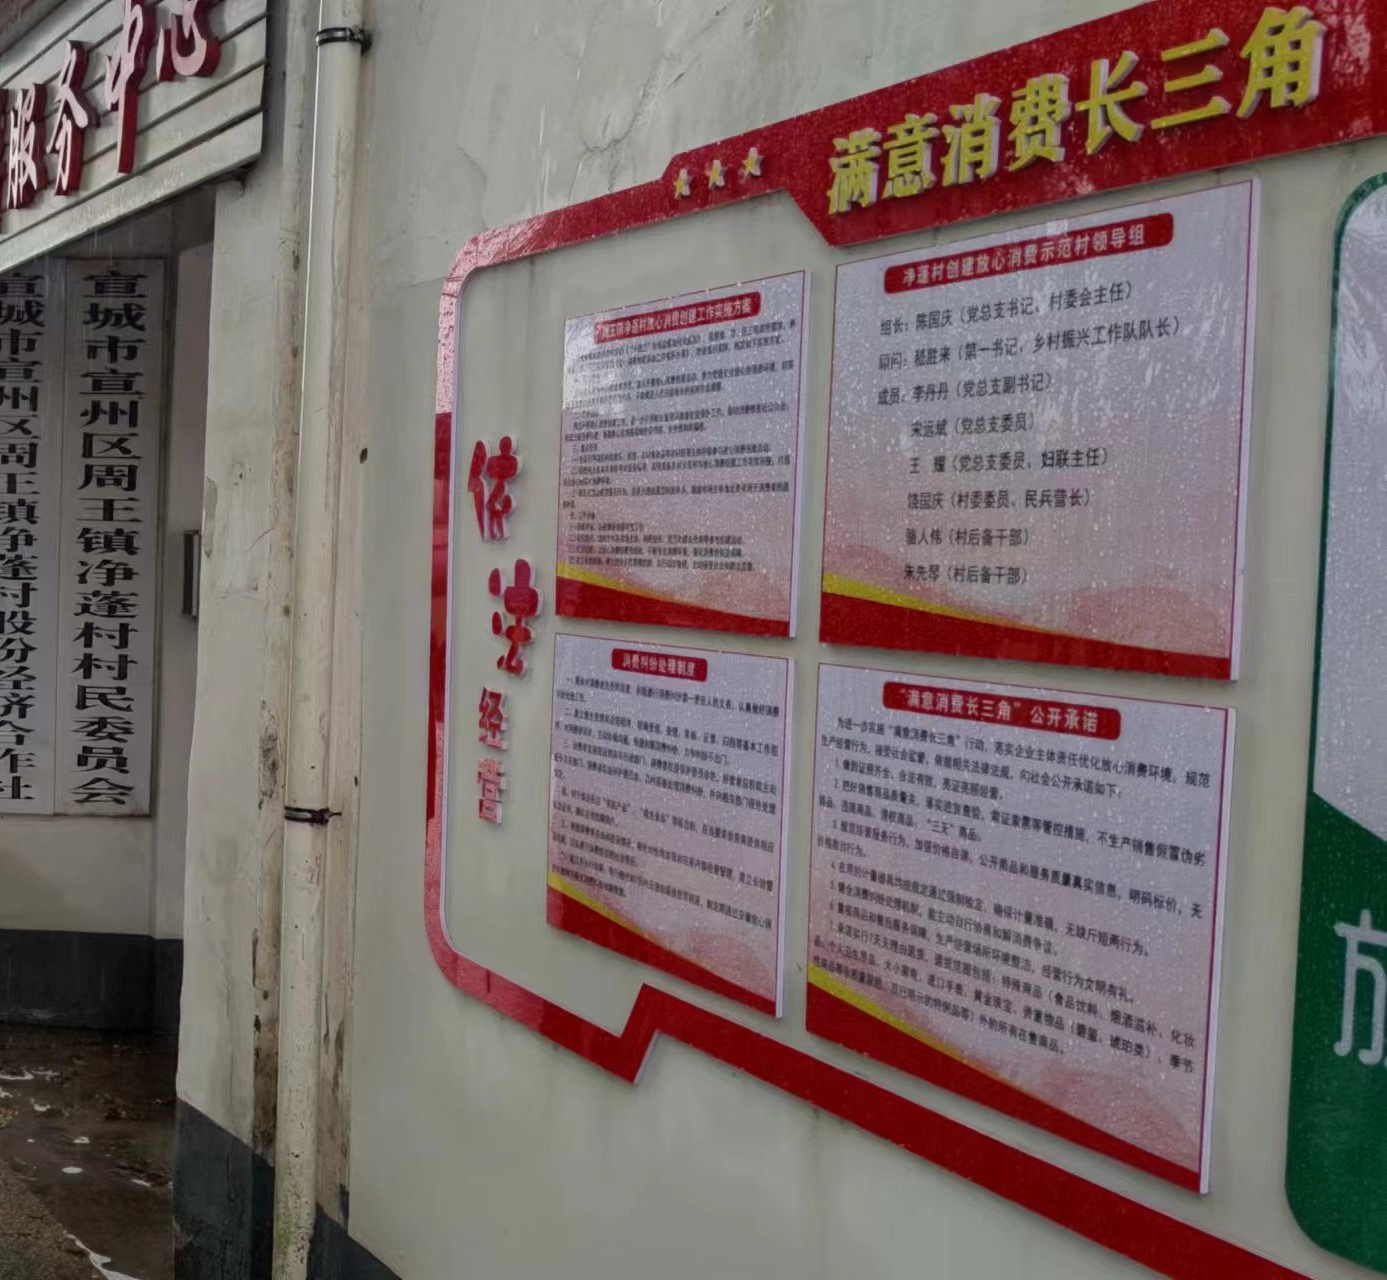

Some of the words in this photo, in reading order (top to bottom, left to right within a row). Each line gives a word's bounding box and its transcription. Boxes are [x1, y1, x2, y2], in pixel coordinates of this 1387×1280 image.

[827, 5, 1326, 214] 满意消费长三角
[902, 222, 1146, 286] 净蓬村创建放心消费示范村领导组
[72, 270, 147, 806] 宣城市宣州区周王镇净蓬村村民委员会
[622, 653, 695, 677] 消费纠纷处理制度
